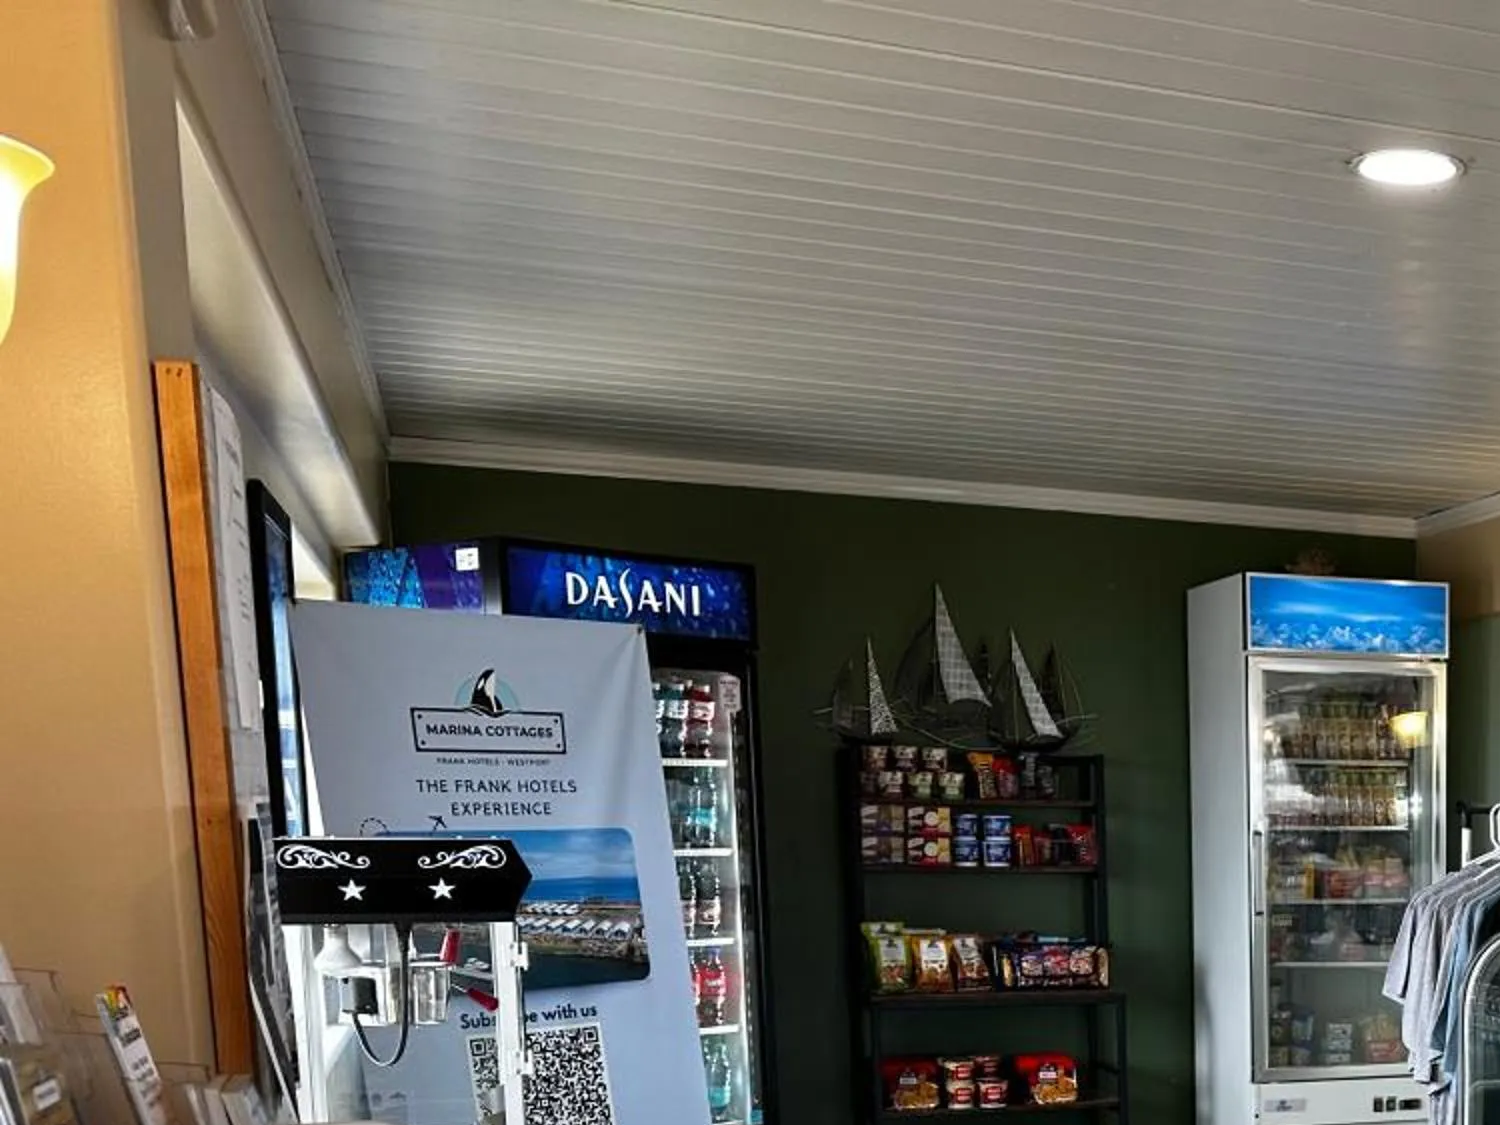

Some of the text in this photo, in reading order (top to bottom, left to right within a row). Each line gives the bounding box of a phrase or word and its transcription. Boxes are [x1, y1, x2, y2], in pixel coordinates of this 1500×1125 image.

[565, 567, 700, 618] DASANI
[425, 724, 553, 739] MARINA COTTAGES
[416, 779, 577, 793] THE FRANK HOTELS
[451, 801, 552, 816] EXPERIENCE
[541, 1003, 577, 1021] with
[580, 1005, 598, 1017] us
